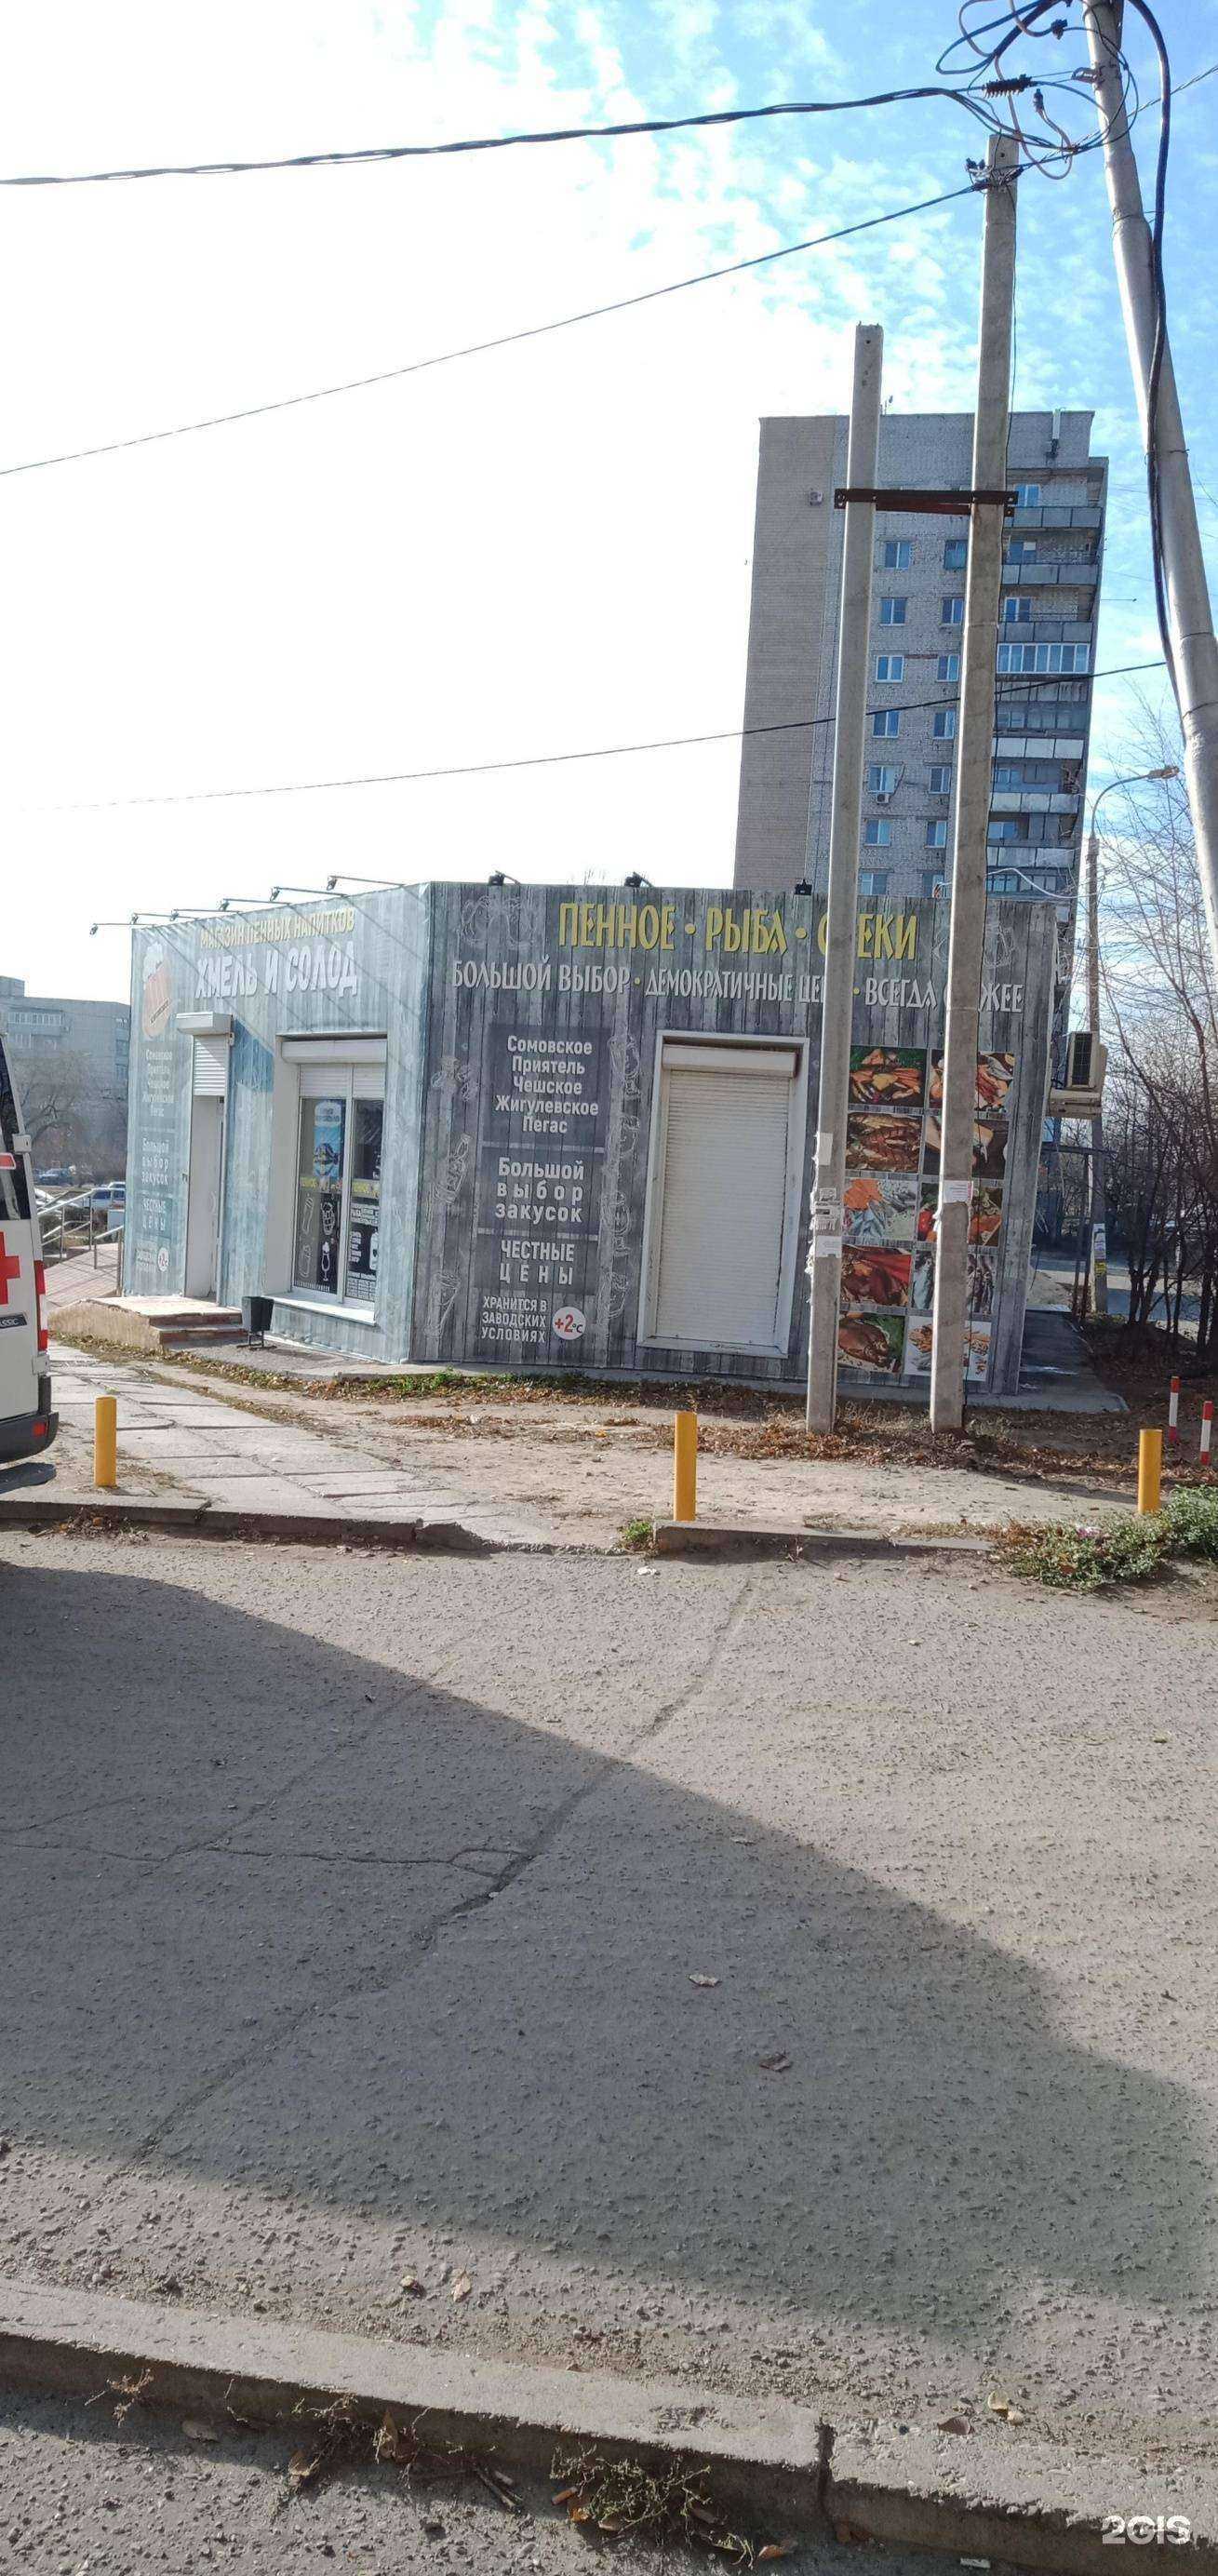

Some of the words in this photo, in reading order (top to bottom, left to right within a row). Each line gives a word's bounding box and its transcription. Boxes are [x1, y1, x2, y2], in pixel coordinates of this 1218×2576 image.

[558, 903, 676, 950] ПЕННОЕ
[705, 906, 788, 955] РЫБА
[194, 954, 258, 999] ХМЕЛЬ
[265, 949, 278, 995] И
[286, 941, 358, 998] СОЛОД
[453, 954, 551, 991] БОЛЬШОЙ
[558, 964, 631, 994] ВЫБОР
[645, 967, 793, 1001] ДЕМОКРАТИЧНЫЕ
[864, 976, 937, 1010] ВСЕГДА
[507, 1035, 593, 1054] Сомовское
[512, 1055, 585, 1075] Приятель
[513, 1076, 582, 1094] Чешское
[495, 1094, 599, 1116] Жигулевское
[522, 1116, 568, 1134] Пегас
[498, 1157, 584, 1180] Большой
[497, 1179, 583, 1205] выбор
[495, 1202, 582, 1225] закусок
[501, 1240, 575, 1262] ЧЕСТНЫЕ
[500, 1263, 573, 1285] ЦЕНЫ
[483, 1295, 538, 1312] ХРАНИТСЯ
[540, 1299, 547, 1312] В
[482, 1311, 546, 1328] ЗАВОДСКИХ
[481, 1326, 545, 1344] УСЛОВИЯХ
